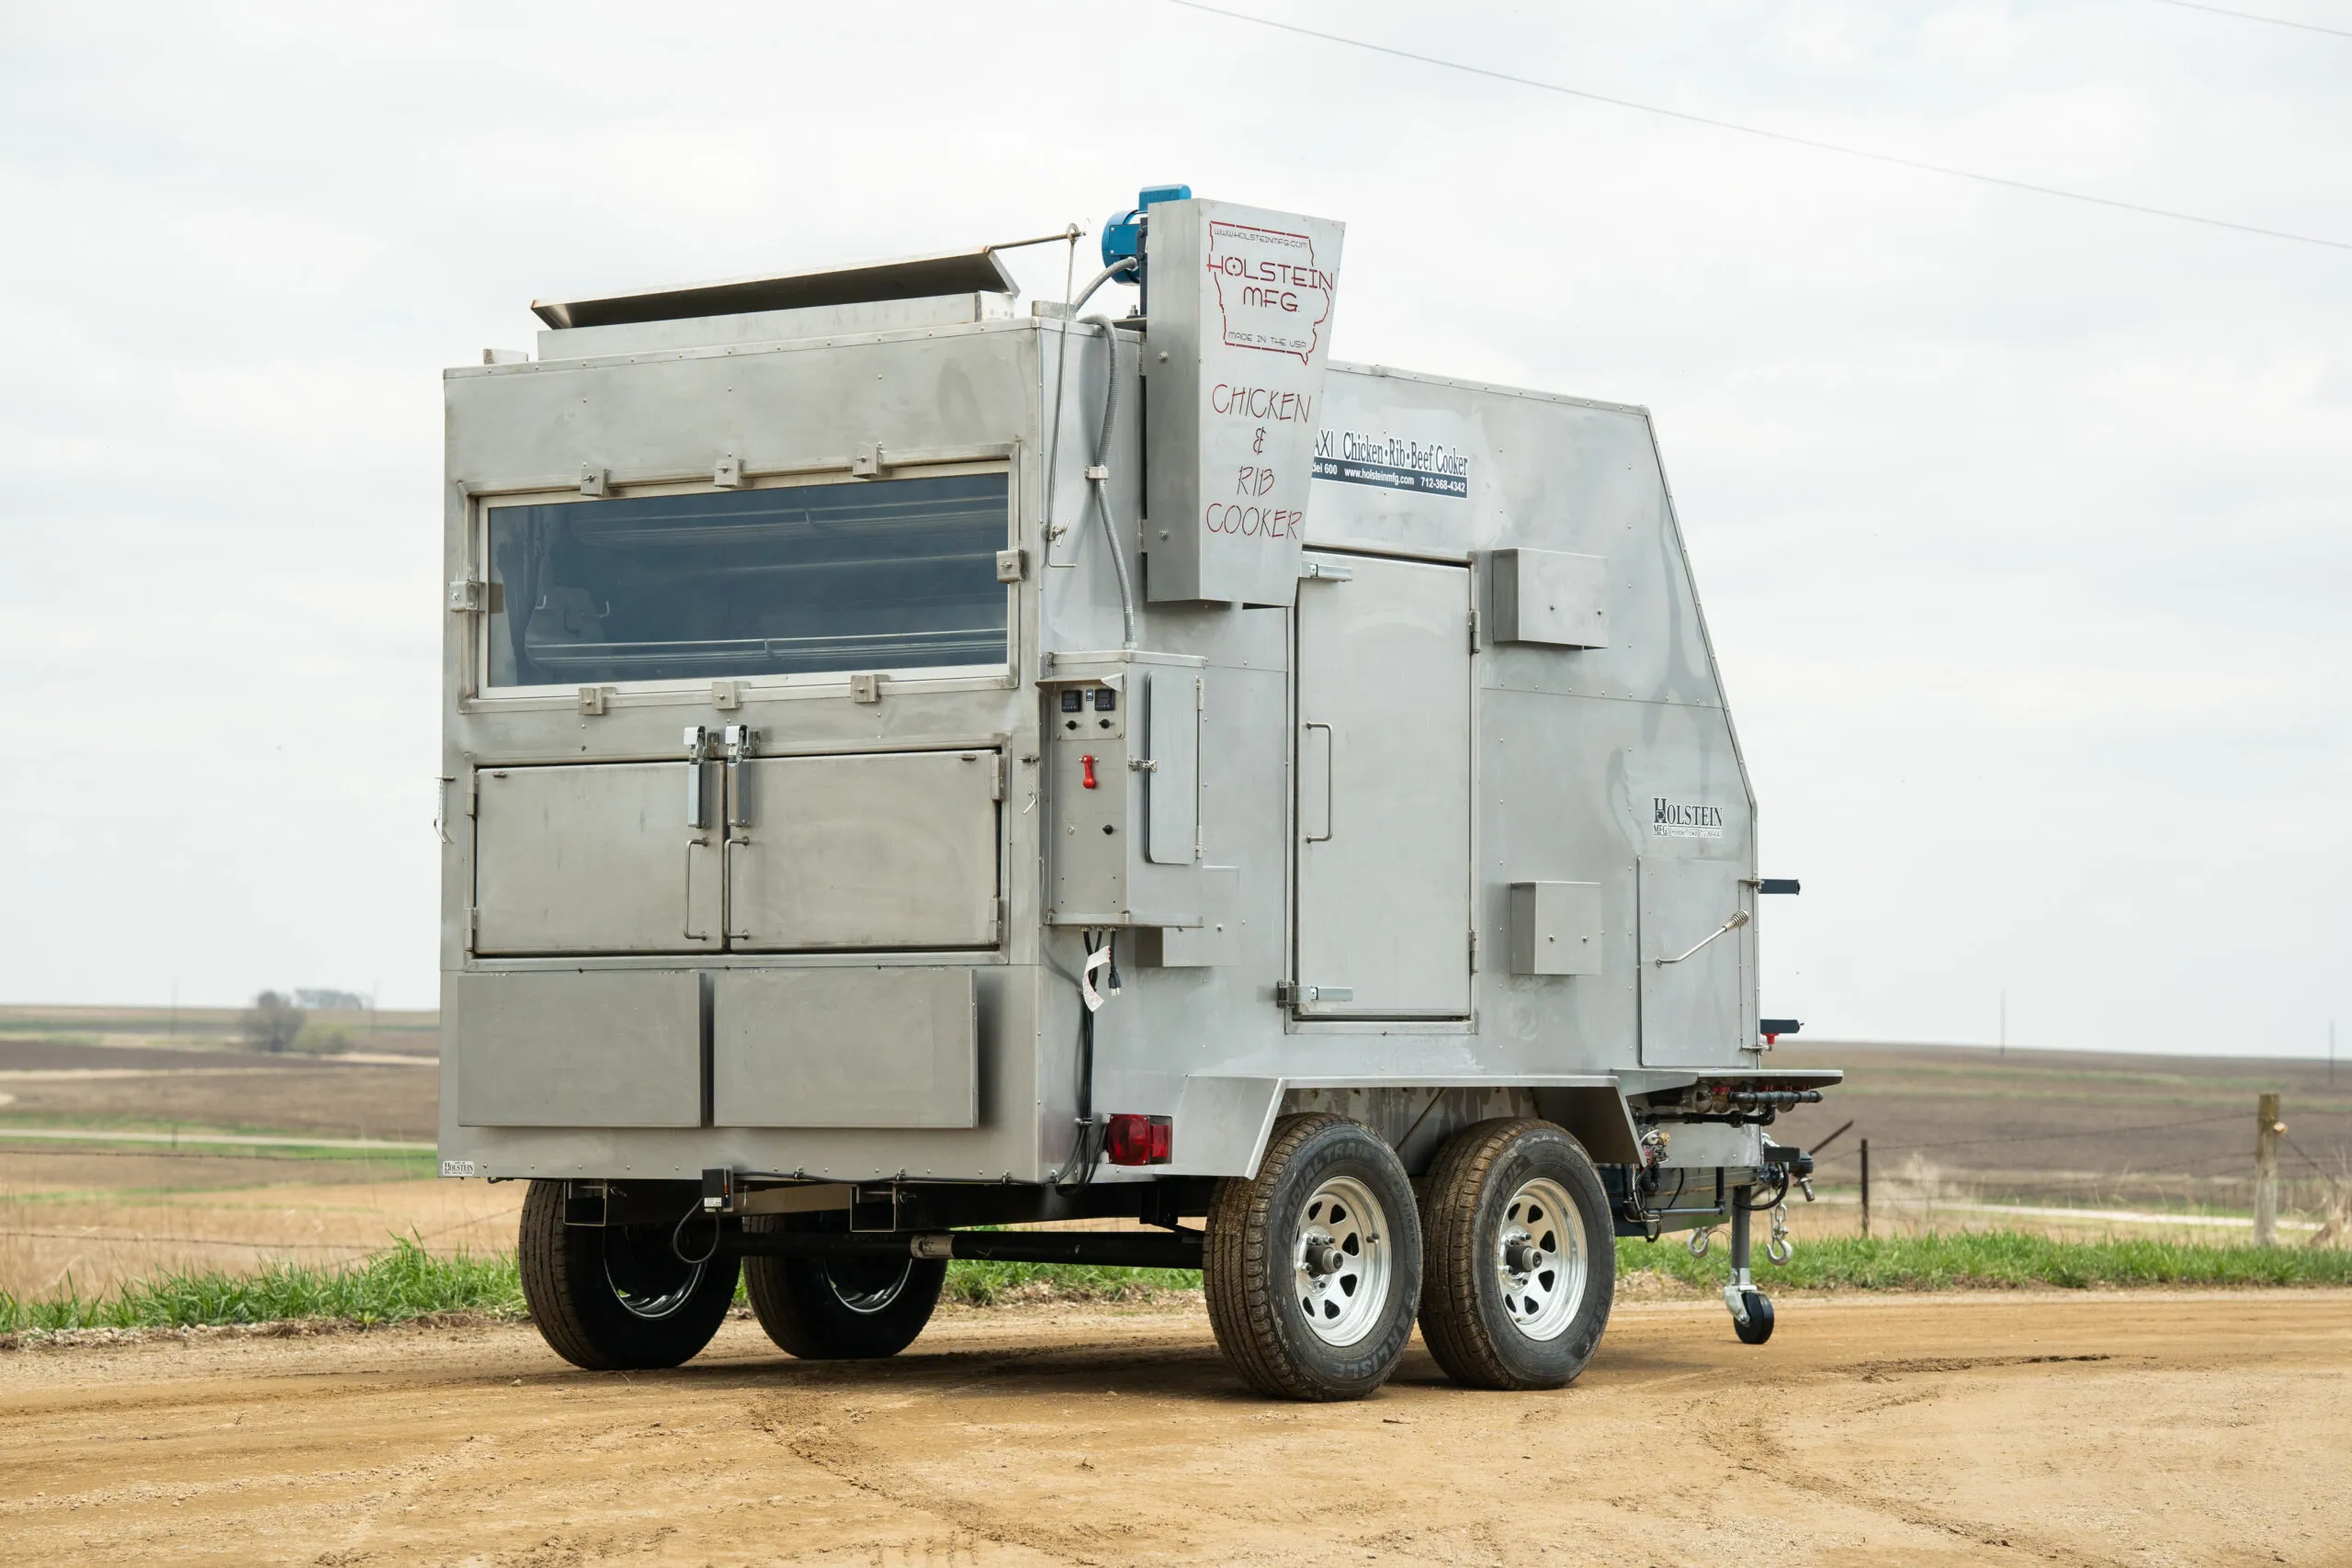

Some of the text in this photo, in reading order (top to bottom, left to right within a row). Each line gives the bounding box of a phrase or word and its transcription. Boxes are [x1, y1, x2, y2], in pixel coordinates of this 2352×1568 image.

[1206, 254, 1333, 290] HOLSTEIN
[1227, 332, 1306, 348] MADE IN THE USA
[1212, 383, 1312, 423] CHICKEN
[1252, 426, 1266, 455] &
[1436, 446, 1468, 476] Cooker
[1237, 466, 1275, 497] RIB
[1324, 463, 1338, 475] 600
[1344, 468, 1414, 486] www.holsteinmfg.com
[1420, 477, 1465, 492] 712-368-4342
[1206, 502, 1303, 539] COOKER
[1654, 797, 1723, 827] HOLSTEIN
[445, 1162, 473, 1171] HOLSTEIN
